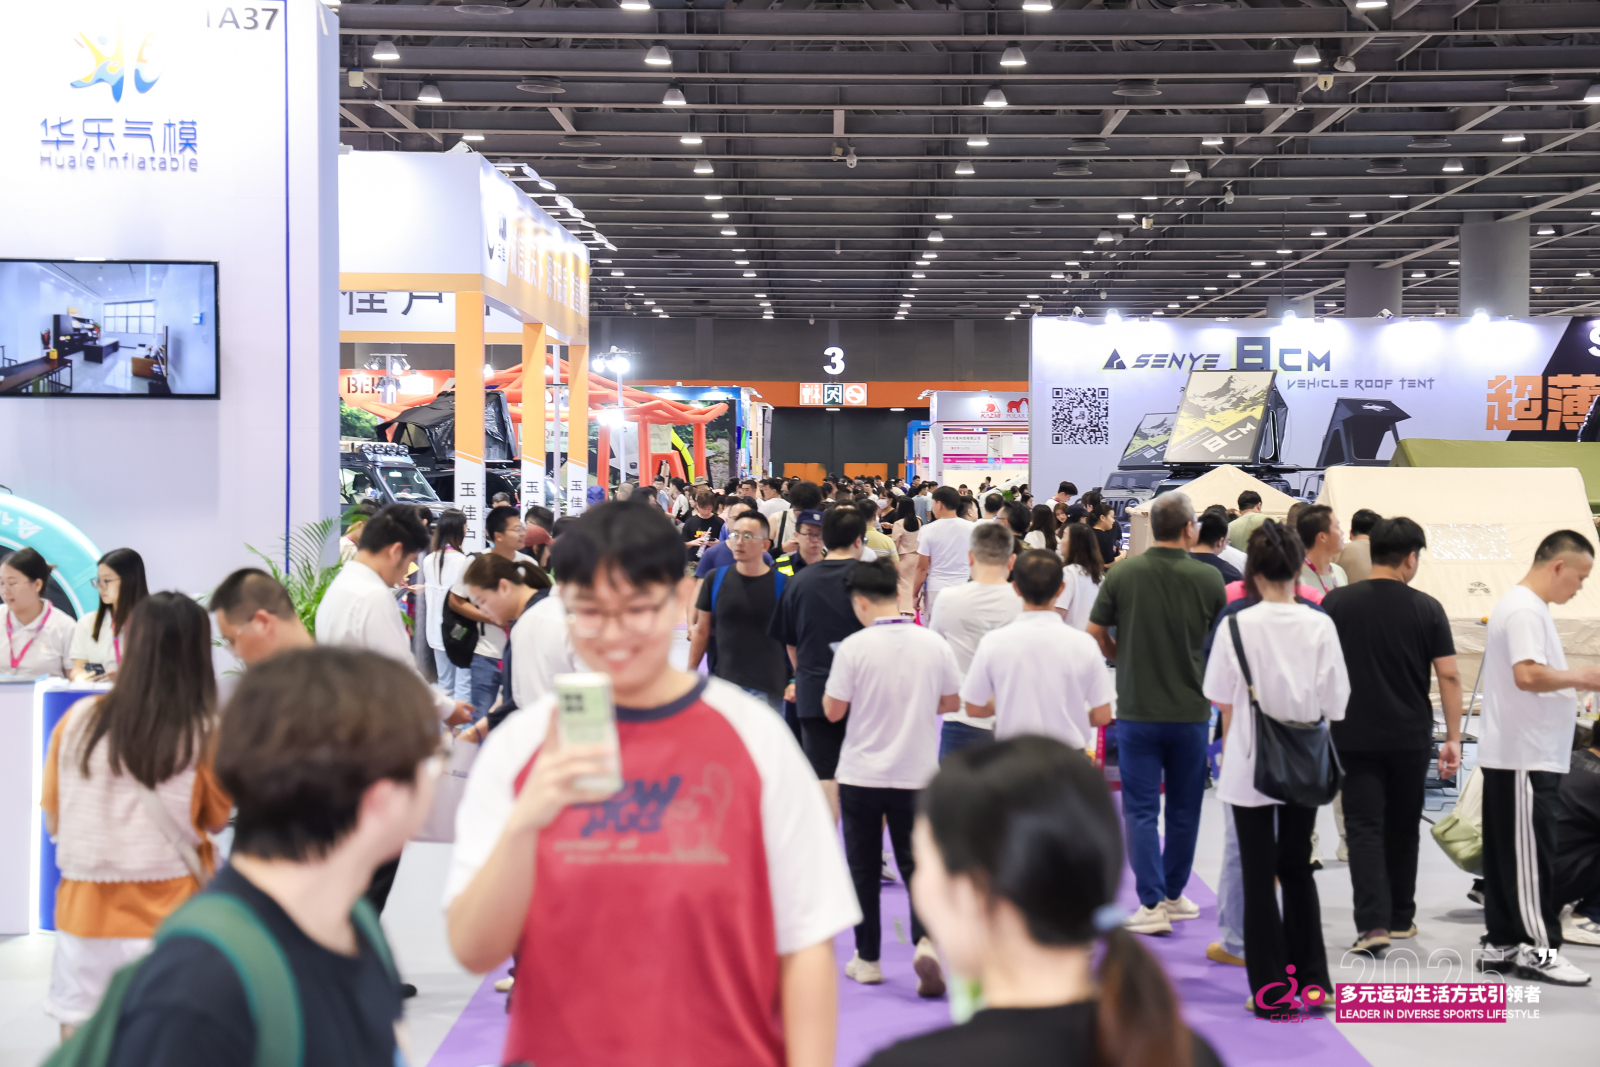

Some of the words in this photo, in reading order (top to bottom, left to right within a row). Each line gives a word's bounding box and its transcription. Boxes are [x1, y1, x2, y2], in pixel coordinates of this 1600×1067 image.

[40, 116, 198, 154] 华乐气模
[40, 151, 96, 169] Huale
[103, 151, 198, 172] Inflatable
[823, 346, 845, 375] 3
[1131, 352, 1221, 369] SENYE
[1286, 378, 1349, 391] VEHICLE
[1354, 379, 1393, 391] ROOF
[1398, 378, 1435, 391] TENT
